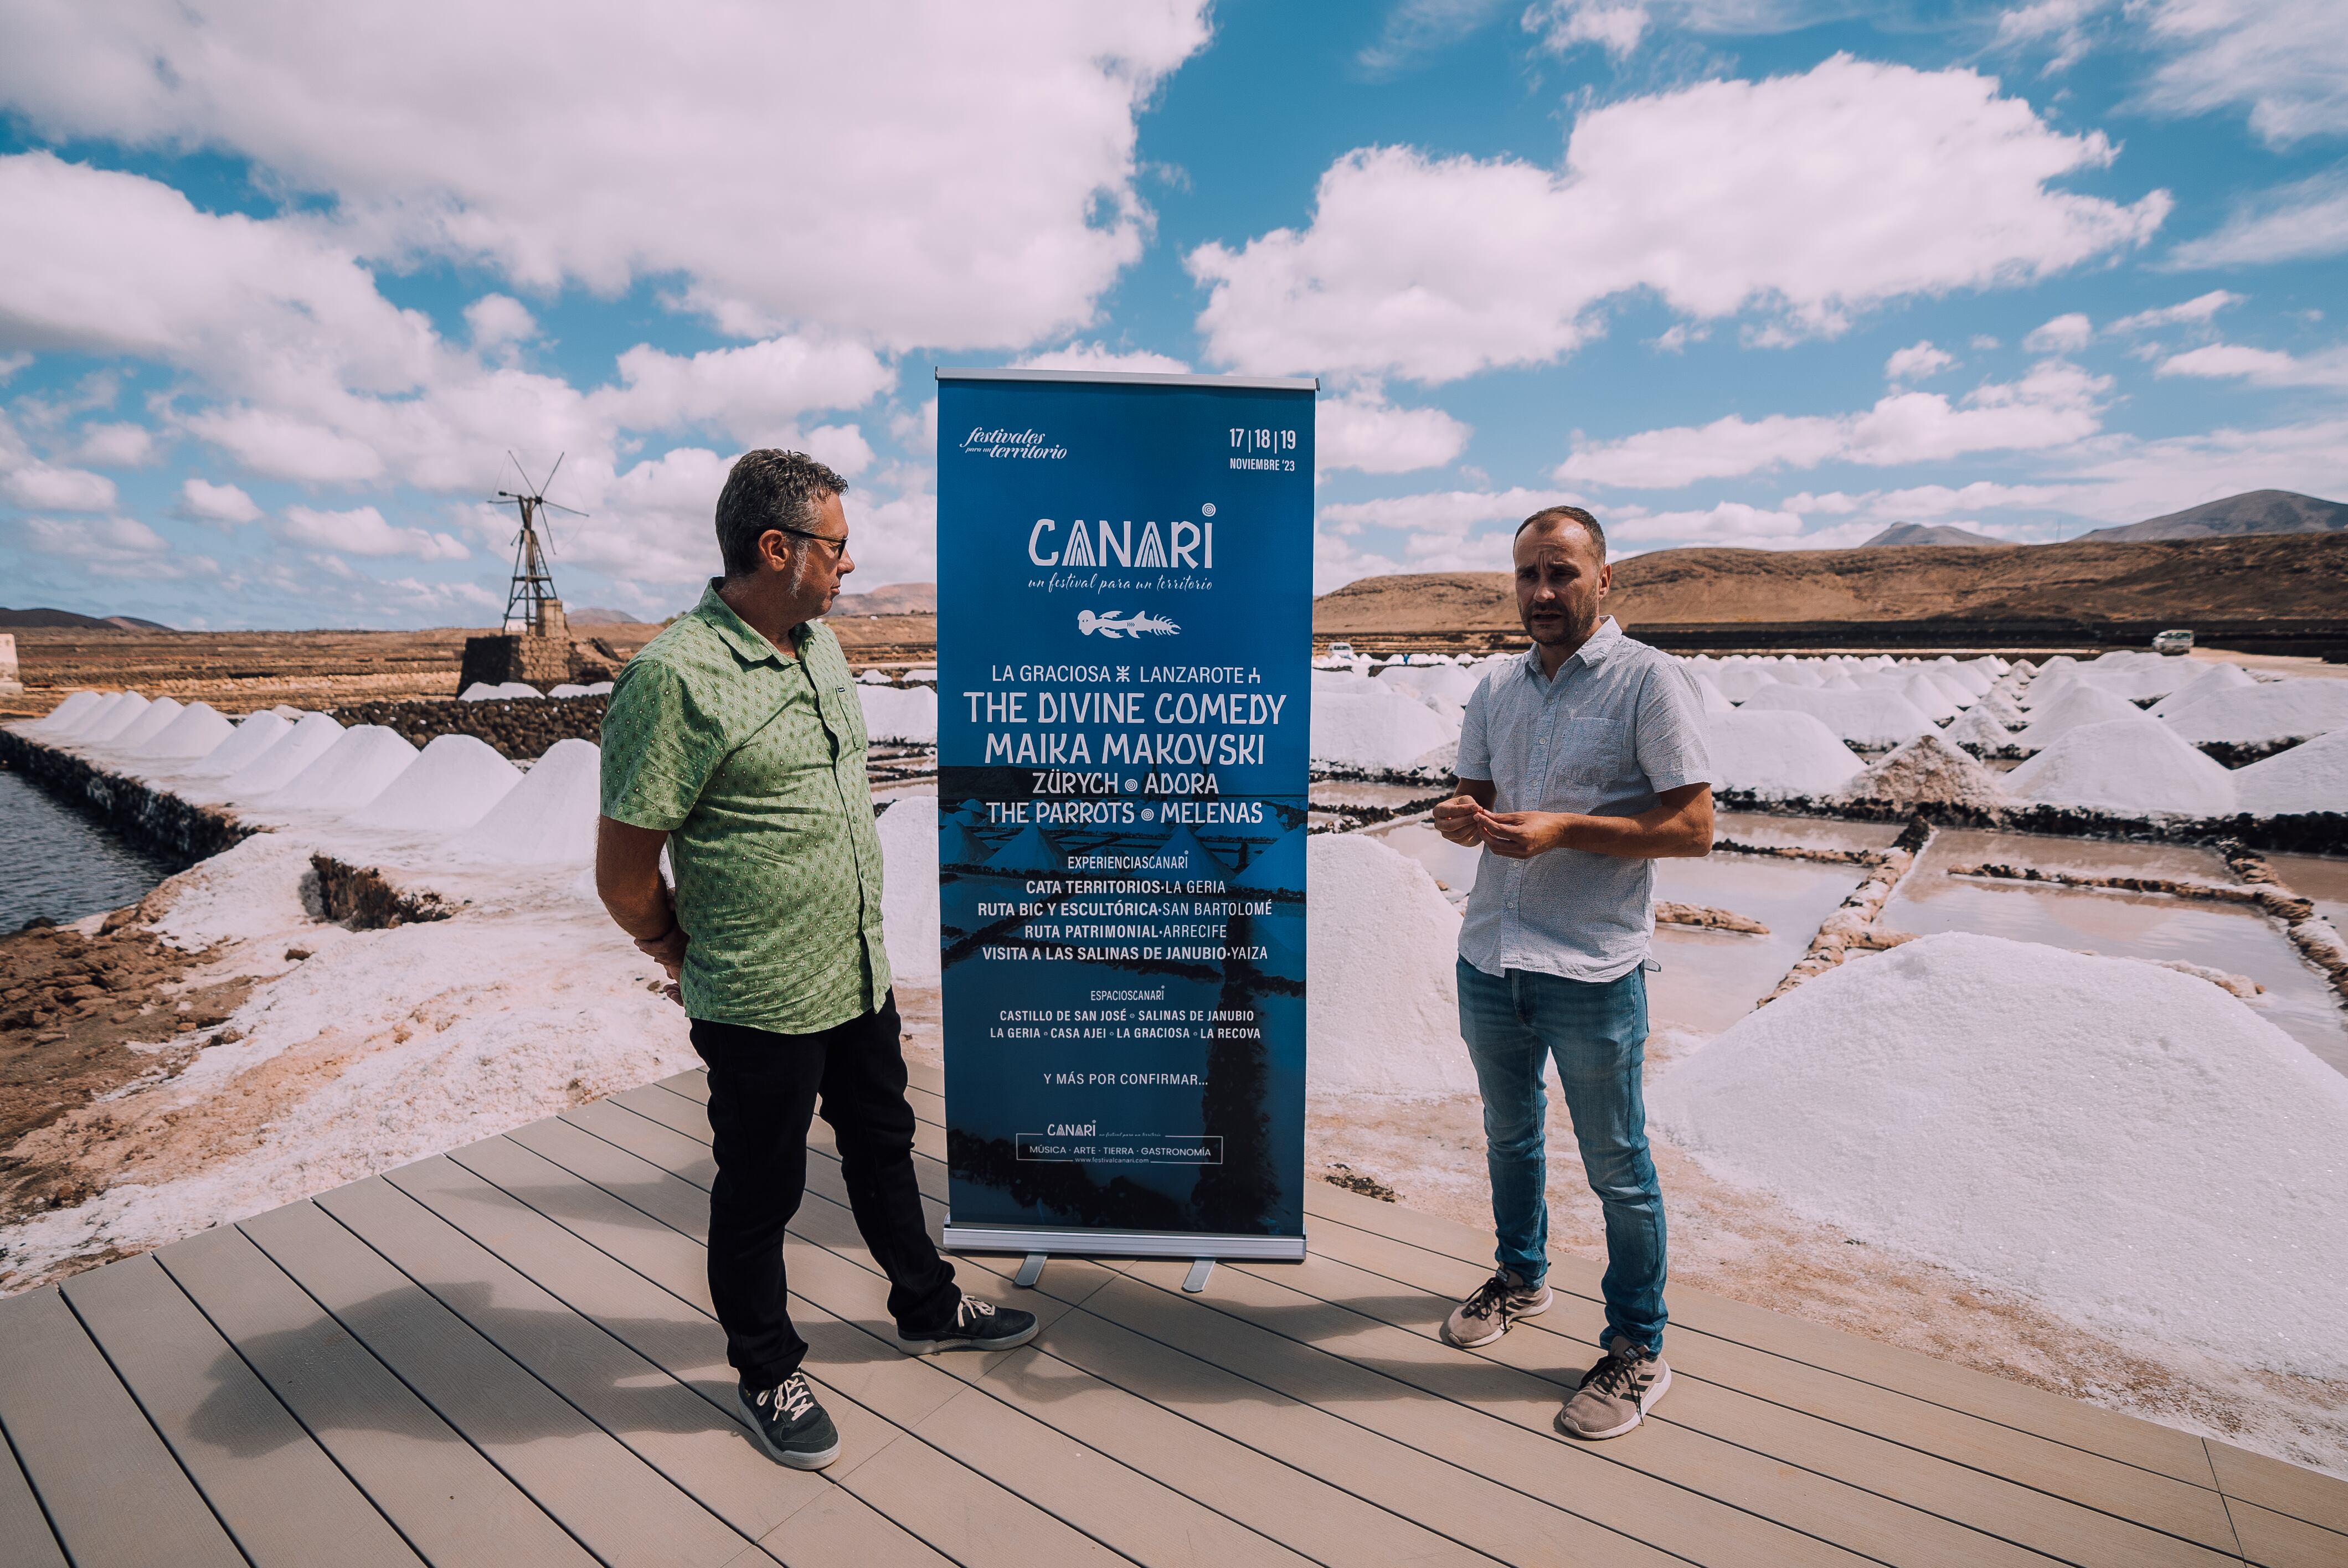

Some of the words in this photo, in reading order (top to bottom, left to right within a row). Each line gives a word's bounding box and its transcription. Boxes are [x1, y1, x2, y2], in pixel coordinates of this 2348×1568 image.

[959, 426, 1046, 447] festivales
[990, 443, 1067, 460] territorio
[1230, 458, 1280, 471] NOVIEMBRE
[1028, 579, 1044, 588] un
[1048, 572, 1096, 593] festival
[1098, 579, 1130, 595] para
[1136, 581, 1152, 590] un
[1156, 574, 1212, 591] territorio
[992, 665, 1015, 682] LA
[1019, 665, 1111, 682] GRACIOSA
[1140, 666, 1244, 683] LANZAROTE
[964, 692, 1028, 723] THE
[1038, 692, 1145, 723] DIVINE
[1155, 693, 1287, 725] COMEDY
[985, 733, 1091, 764] MAIKA
[1101, 734, 1264, 765] MAKOVSKI
[1032, 768, 1118, 794] ZÜRYCH
[1144, 772, 1219, 795] ADORA
[986, 802, 1029, 823] THE
[1036, 802, 1135, 824] PARROTS
[1160, 802, 1263, 823] MELENAS
[1026, 880, 1062, 894] CATA
[1187, 880, 1226, 894] GERIA
[978, 902, 1015, 916] RUTA
[1019, 902, 1043, 916] BIC
[1047, 902, 1057, 916] Y
[1194, 899, 1272, 916] BARTOLOMÉ
[1025, 925, 1060, 938] RUTA
[982, 947, 1028, 960] VISITA
[1032, 947, 1042, 960] A
[1046, 947, 1073, 960] LAS
[1077, 947, 1139, 960] SALINAS
[1144, 947, 1162, 960] DE
[1000, 1010, 1053, 1021] CASTILLO
[1057, 1010, 1070, 1021] DE
[1074, 1010, 1096, 1021] SAN
[1100, 1008, 1126, 1021] JOSÉ
[1138, 1010, 1186, 1021] SALINAS
[1190, 1010, 1203, 1021] DE
[1207, 1010, 1254, 1021] JANUBIO
[990, 1028, 1004, 1038] LA
[1007, 1028, 1041, 1038] GERIA
[1051, 1028, 1080, 1038] CASA
[1083, 1028, 1106, 1038] AJEI
[1117, 1028, 1130, 1038] LA
[1134, 1028, 1190, 1038] GRACIOSA
[1201, 1028, 1214, 1039] LA
[1218, 1028, 1260, 1039] RECOVA
[1043, 1074, 1052, 1084] Y
[1057, 1071, 1084, 1085] MÁS
[1089, 1074, 1115, 1085] POR
[1120, 1074, 1208, 1085] CONFIRMAR...
[1029, 1144, 1067, 1154] MÚSICA
[1104, 1147, 1134, 1155] TIERRA
[1141, 1147, 1211, 1156] GASTRONOMÍA
